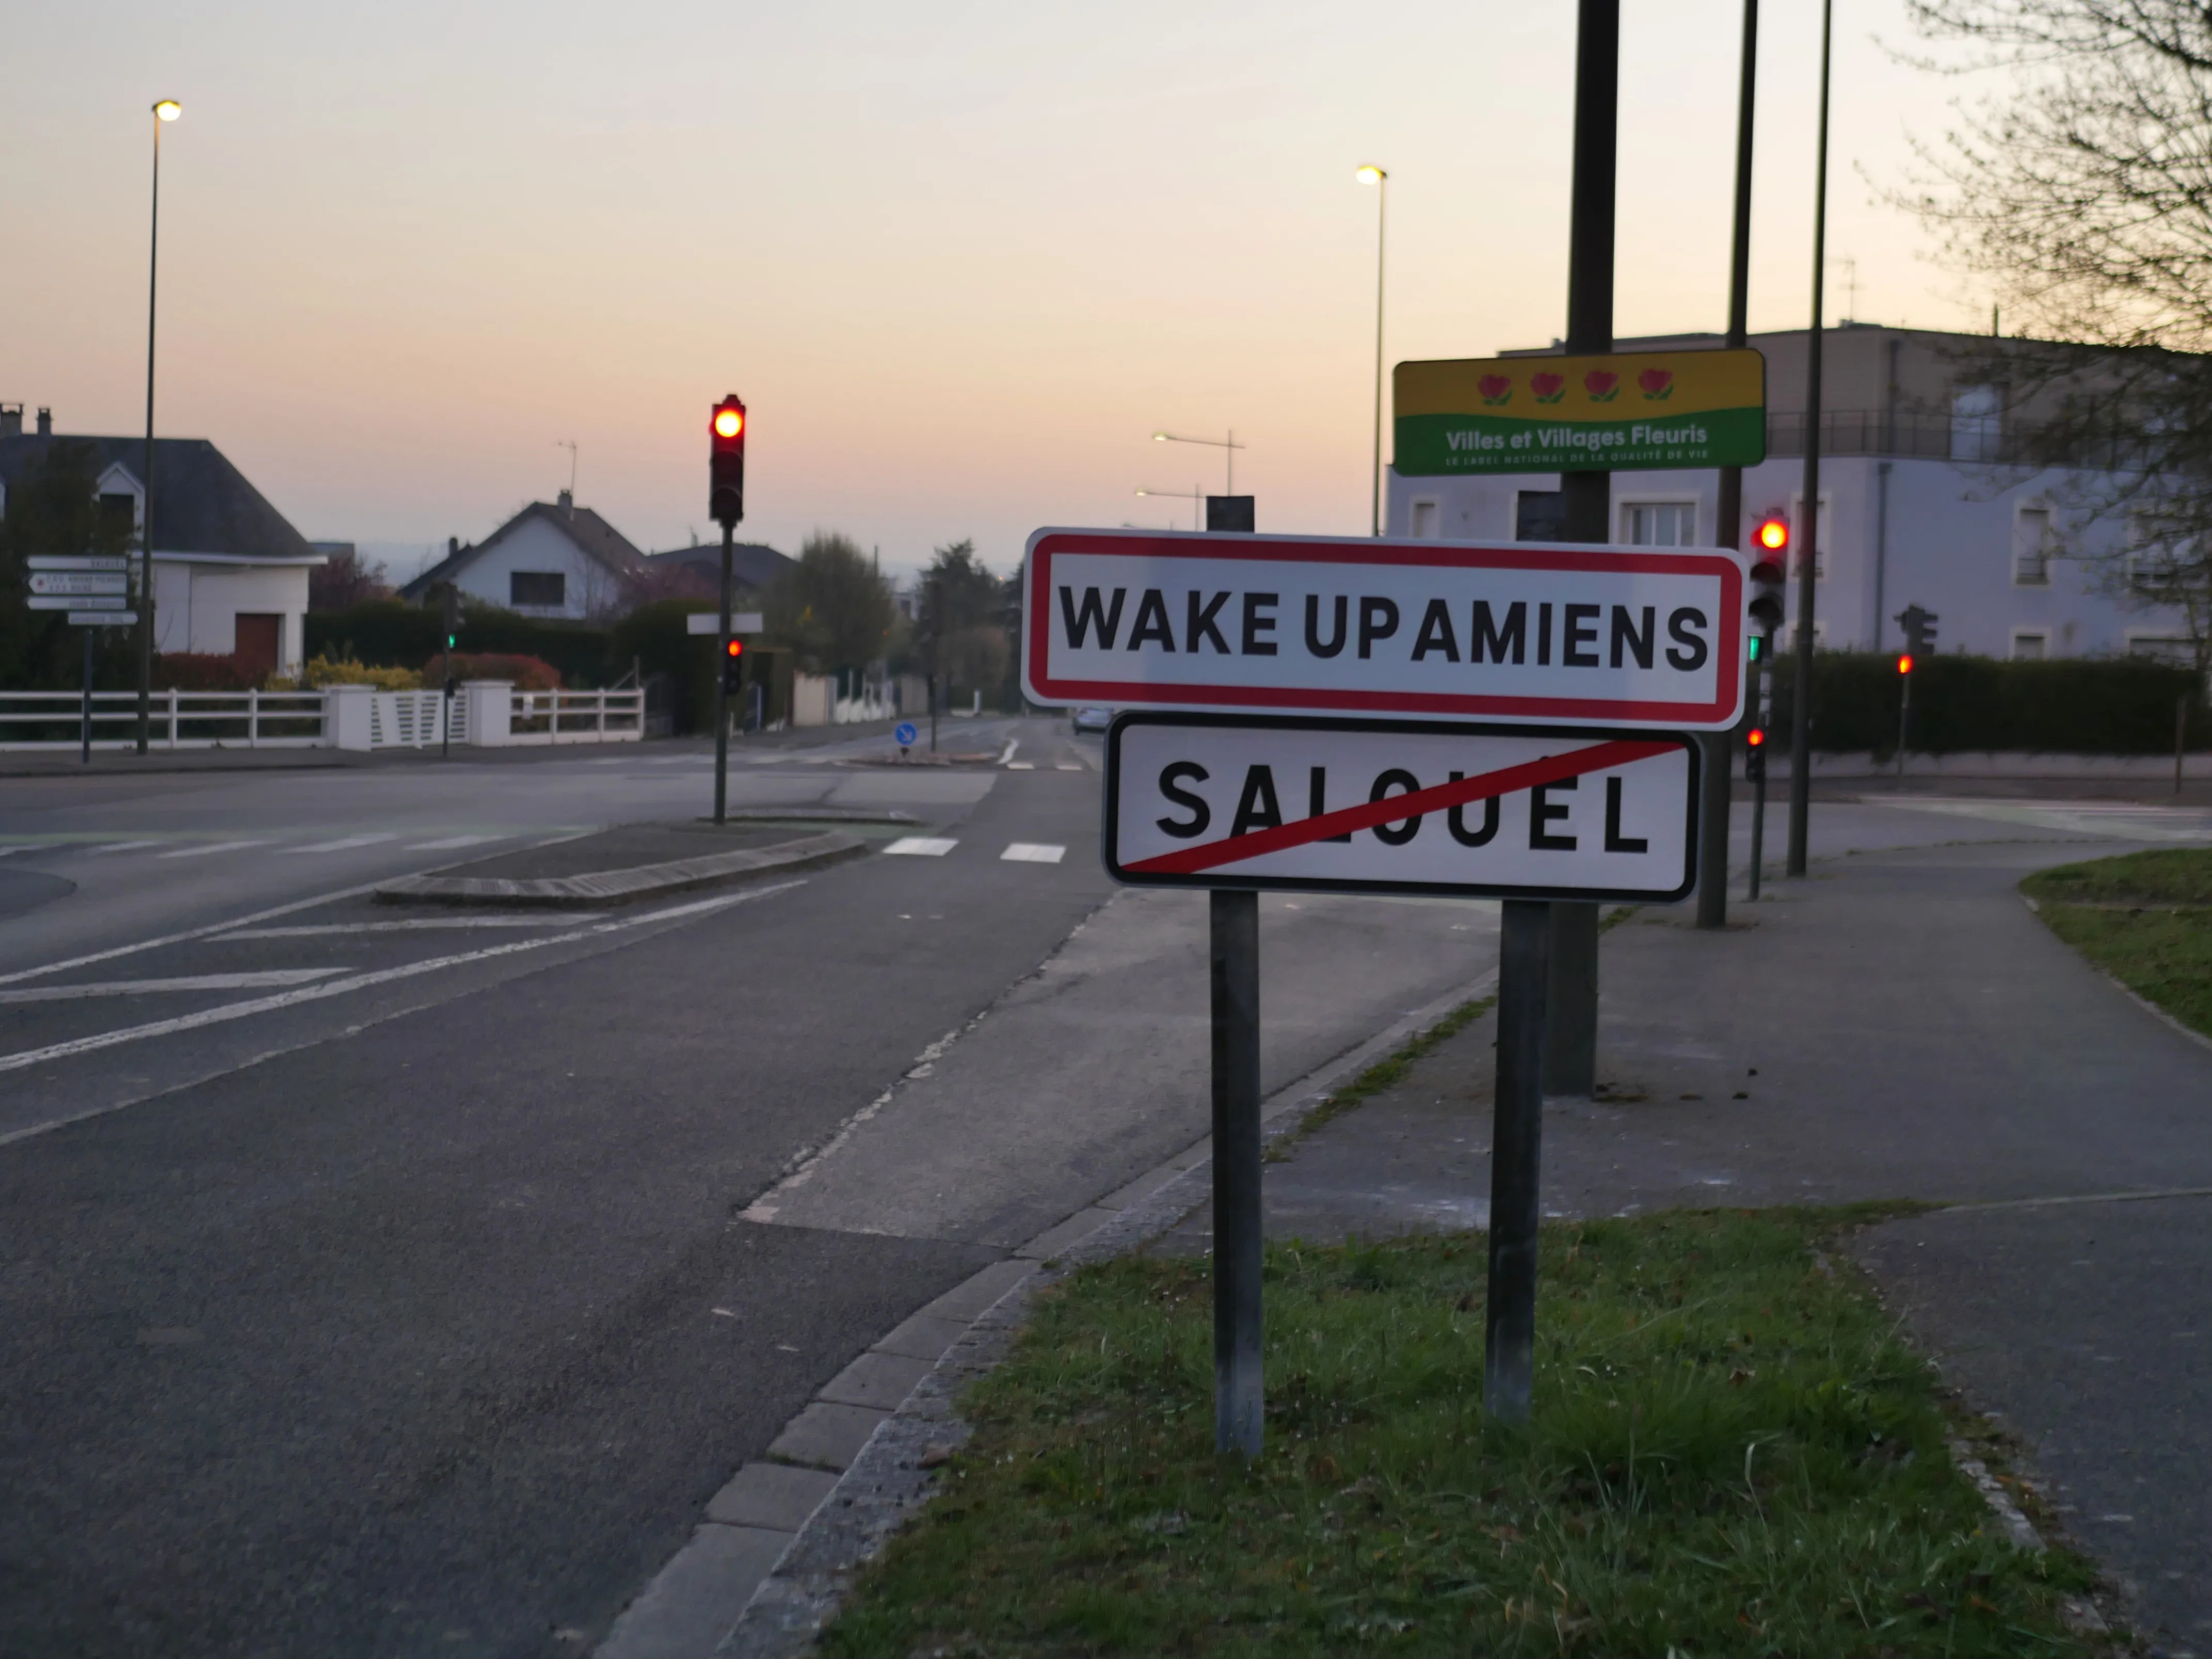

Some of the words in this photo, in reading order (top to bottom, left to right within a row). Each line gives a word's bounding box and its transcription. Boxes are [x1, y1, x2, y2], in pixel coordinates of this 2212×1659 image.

[1446, 429, 1505, 450] Villes
[1510, 430, 1532, 449] et
[1537, 427, 1625, 452] Villages
[1631, 424, 1708, 445] Fleuris
[1446, 457, 1458, 466] LE
[1464, 455, 1498, 465] LABEL
[1504, 454, 1564, 464] NATIONAL
[1570, 453, 1584, 462] DE
[1591, 452, 1604, 462] LA
[1610, 449, 1662, 462] QUALITÉ
[1668, 450, 1682, 460] DE
[1688, 449, 1708, 459] VIE
[1058, 586, 1279, 656] WAKE
